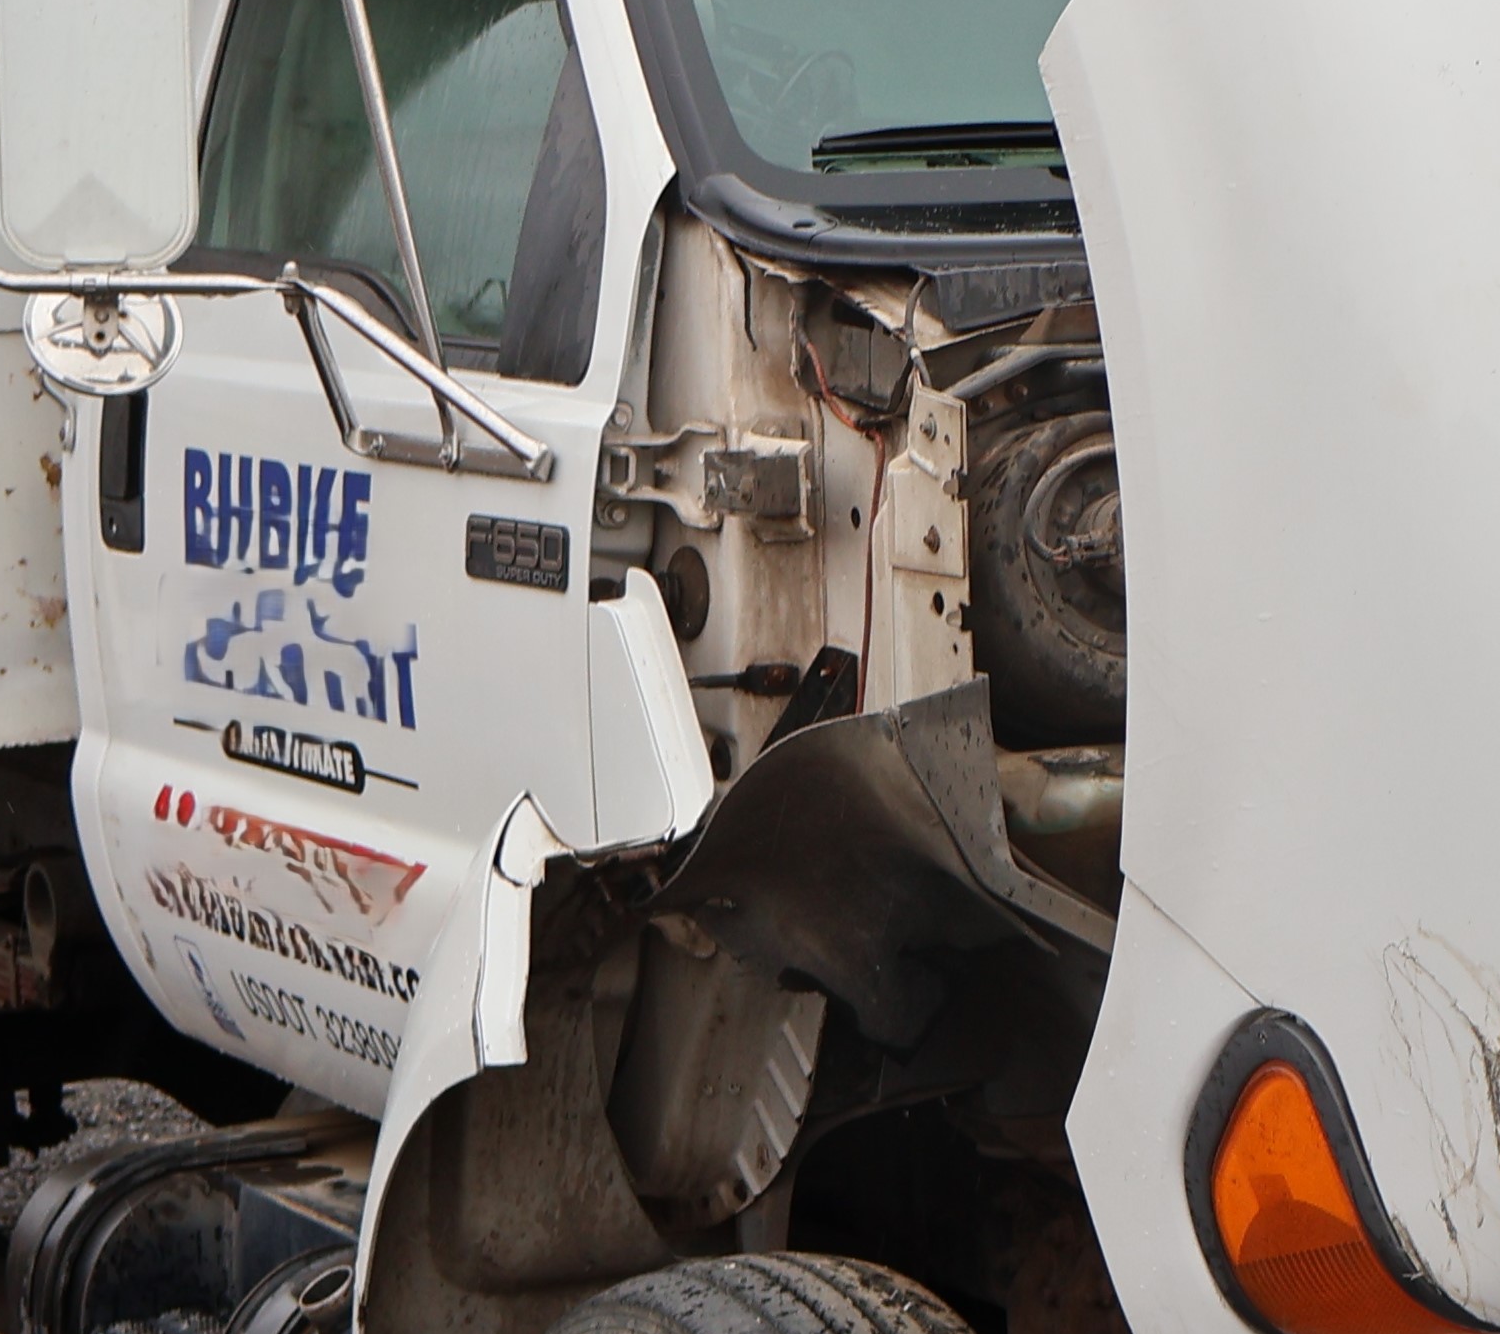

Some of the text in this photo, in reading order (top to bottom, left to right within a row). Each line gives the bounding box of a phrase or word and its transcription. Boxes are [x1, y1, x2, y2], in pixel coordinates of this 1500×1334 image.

[496, 565, 563, 587] SUPER DUTY
[230, 969, 318, 1042] USDOT
[315, 1004, 403, 1070] 323809
